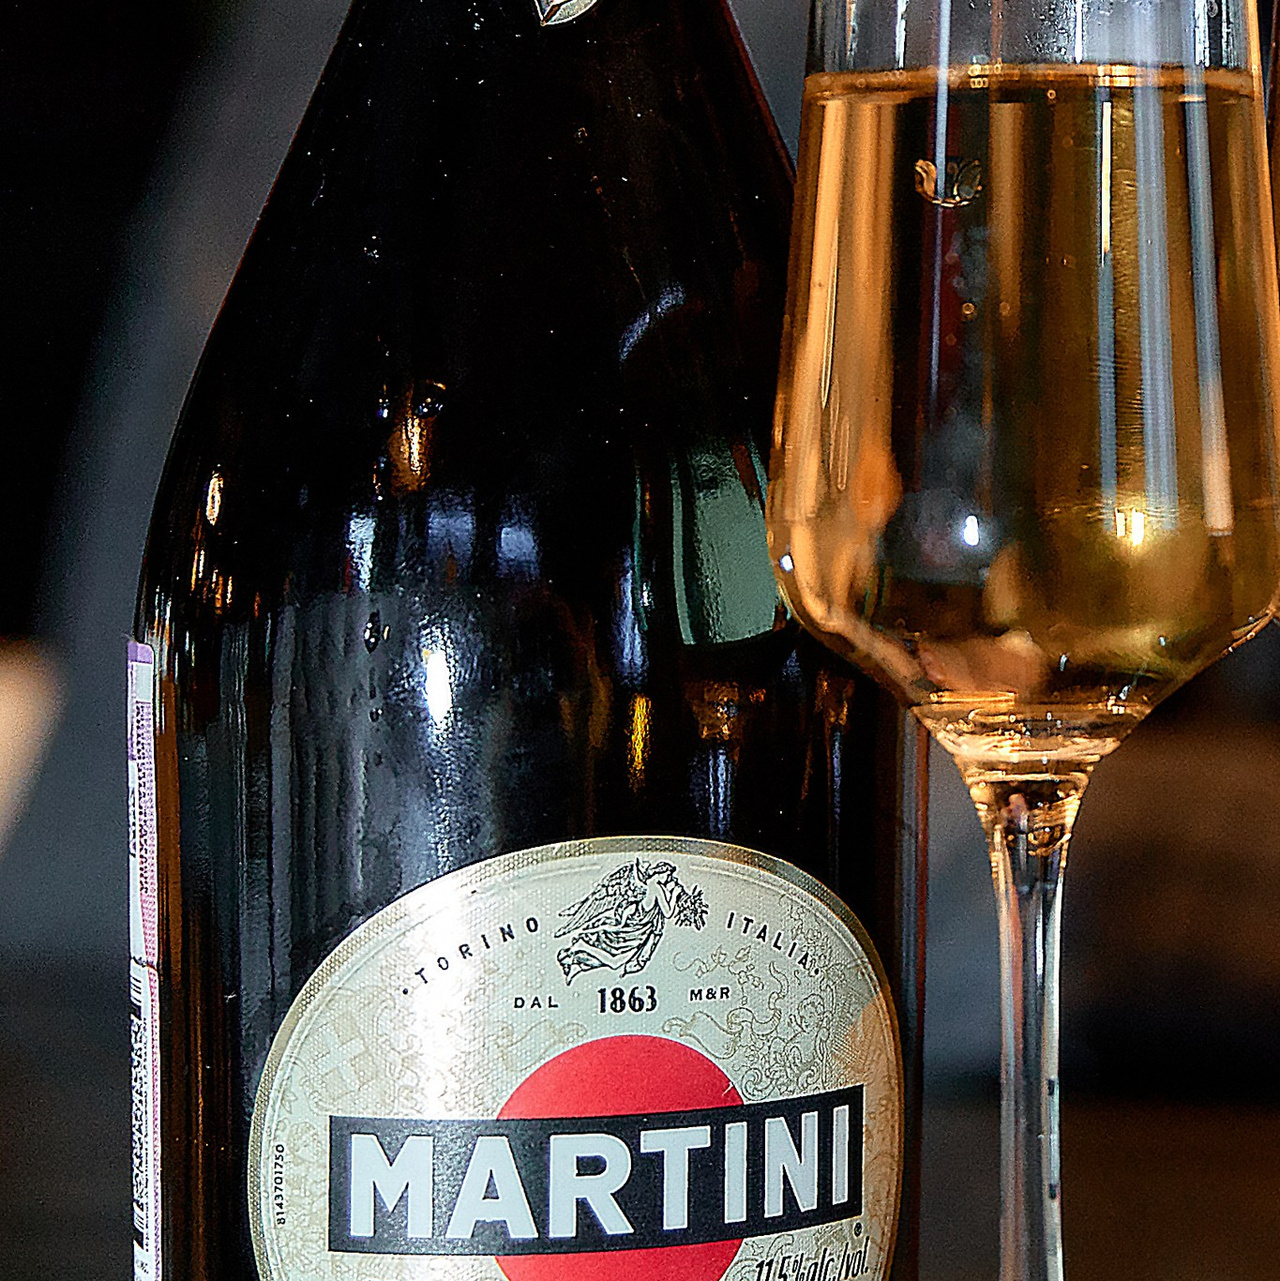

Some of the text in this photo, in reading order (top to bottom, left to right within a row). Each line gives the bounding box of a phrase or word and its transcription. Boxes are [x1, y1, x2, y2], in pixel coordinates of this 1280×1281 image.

[415, 912, 809, 984] TORINO ITALIA
[513, 986, 730, 1013] DAL 1863 M&R
[274, 1144, 286, 1225] 8143701750
[349, 1104, 849, 1238] MARTINI
